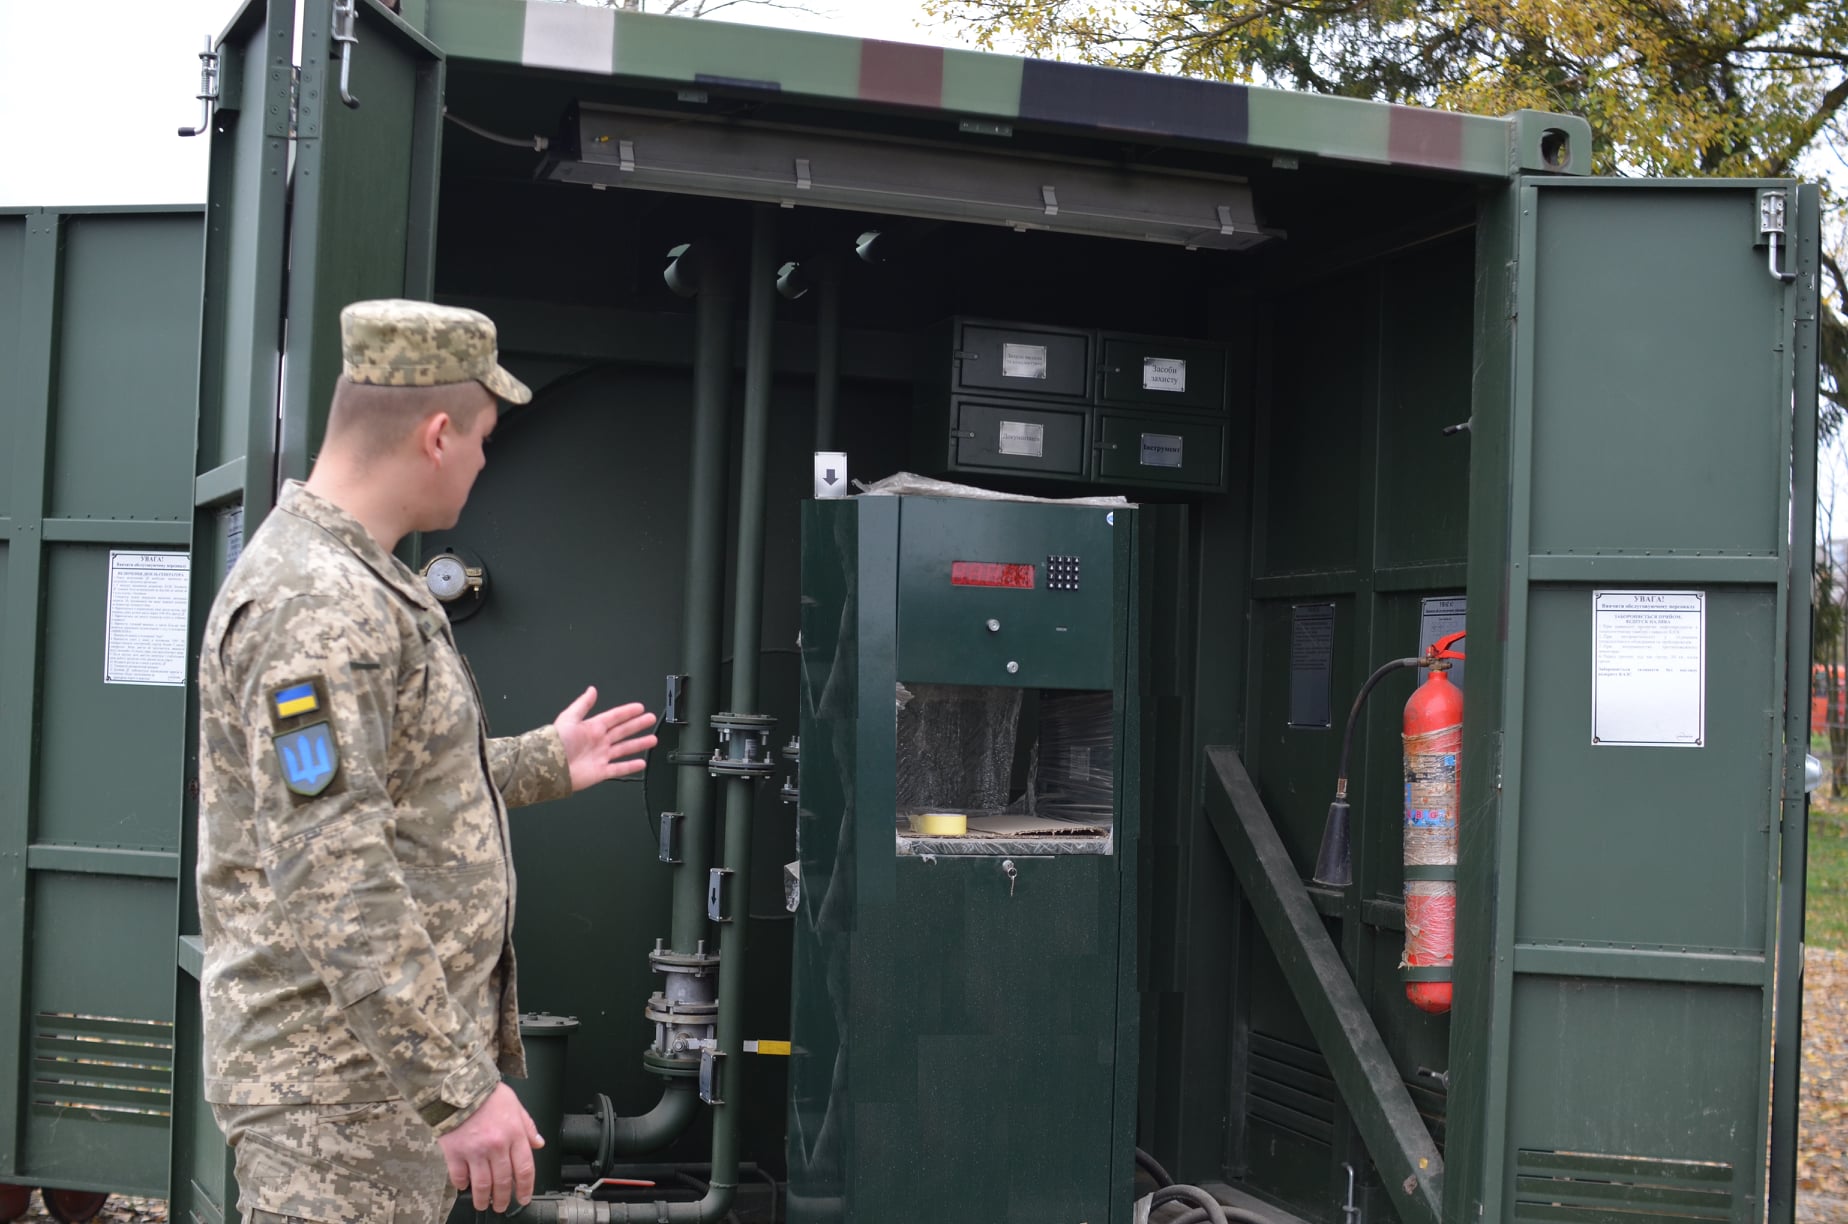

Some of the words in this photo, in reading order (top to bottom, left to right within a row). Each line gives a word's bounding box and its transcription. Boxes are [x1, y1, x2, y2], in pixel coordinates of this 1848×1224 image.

[1152, 364, 1177, 374] Засоби
[1151, 376, 1178, 386] захисту
[1633, 595, 1665, 603] УВАГА!
